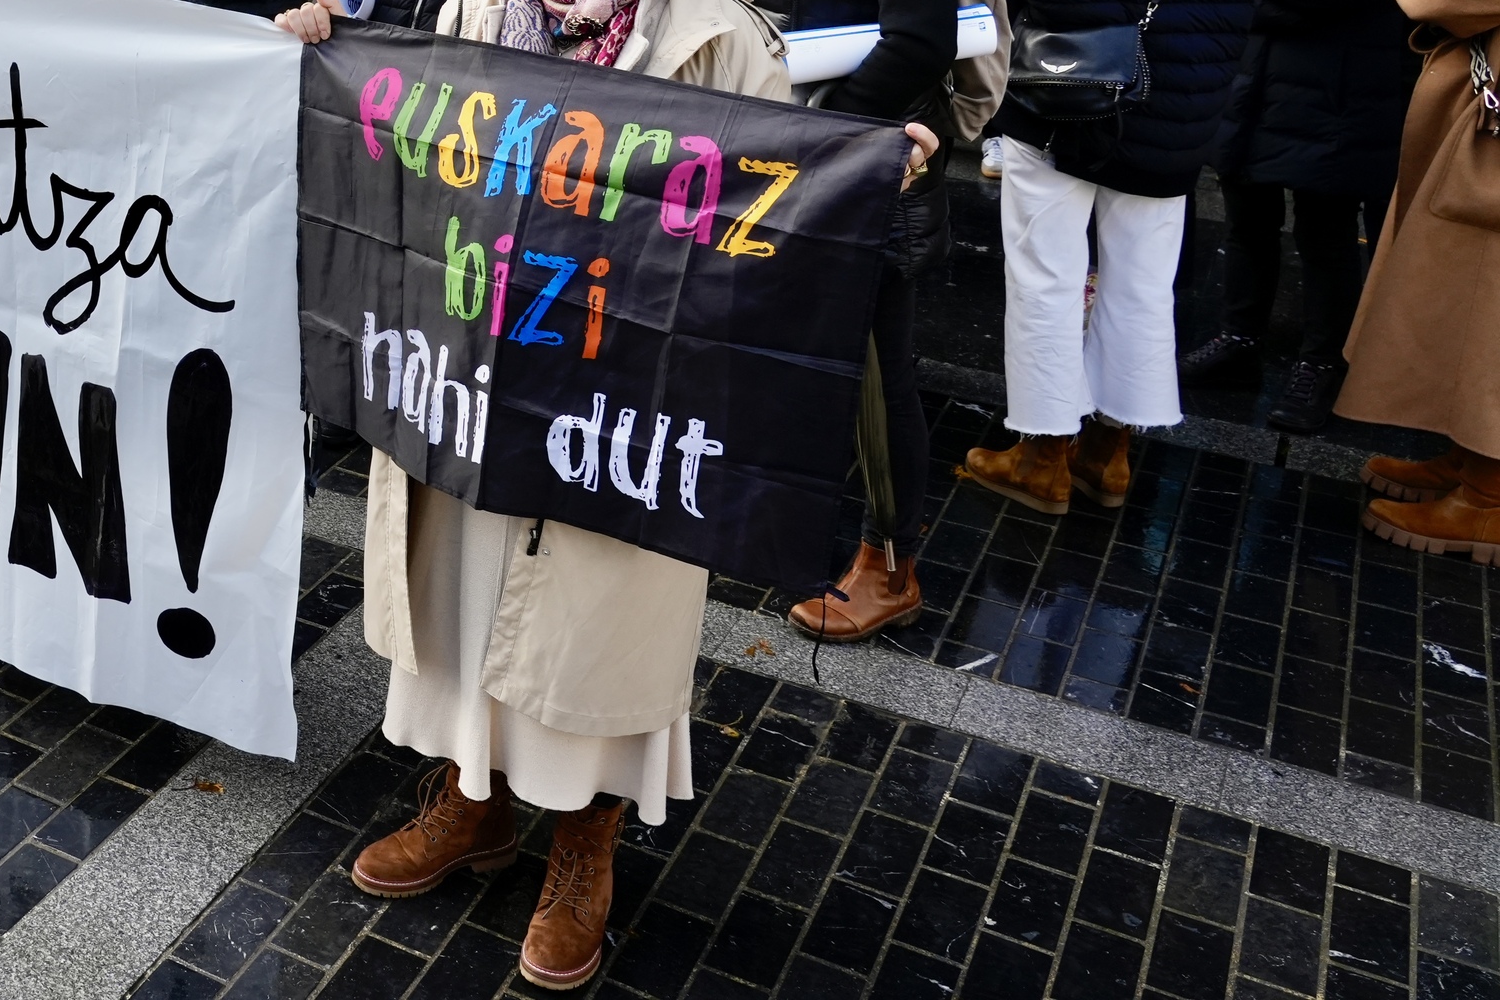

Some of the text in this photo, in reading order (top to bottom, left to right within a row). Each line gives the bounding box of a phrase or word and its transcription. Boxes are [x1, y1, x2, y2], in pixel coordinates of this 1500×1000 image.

[359, 67, 800, 258] euskaraz
[444, 216, 608, 360] bizi
[361, 310, 724, 519] nahi dut
